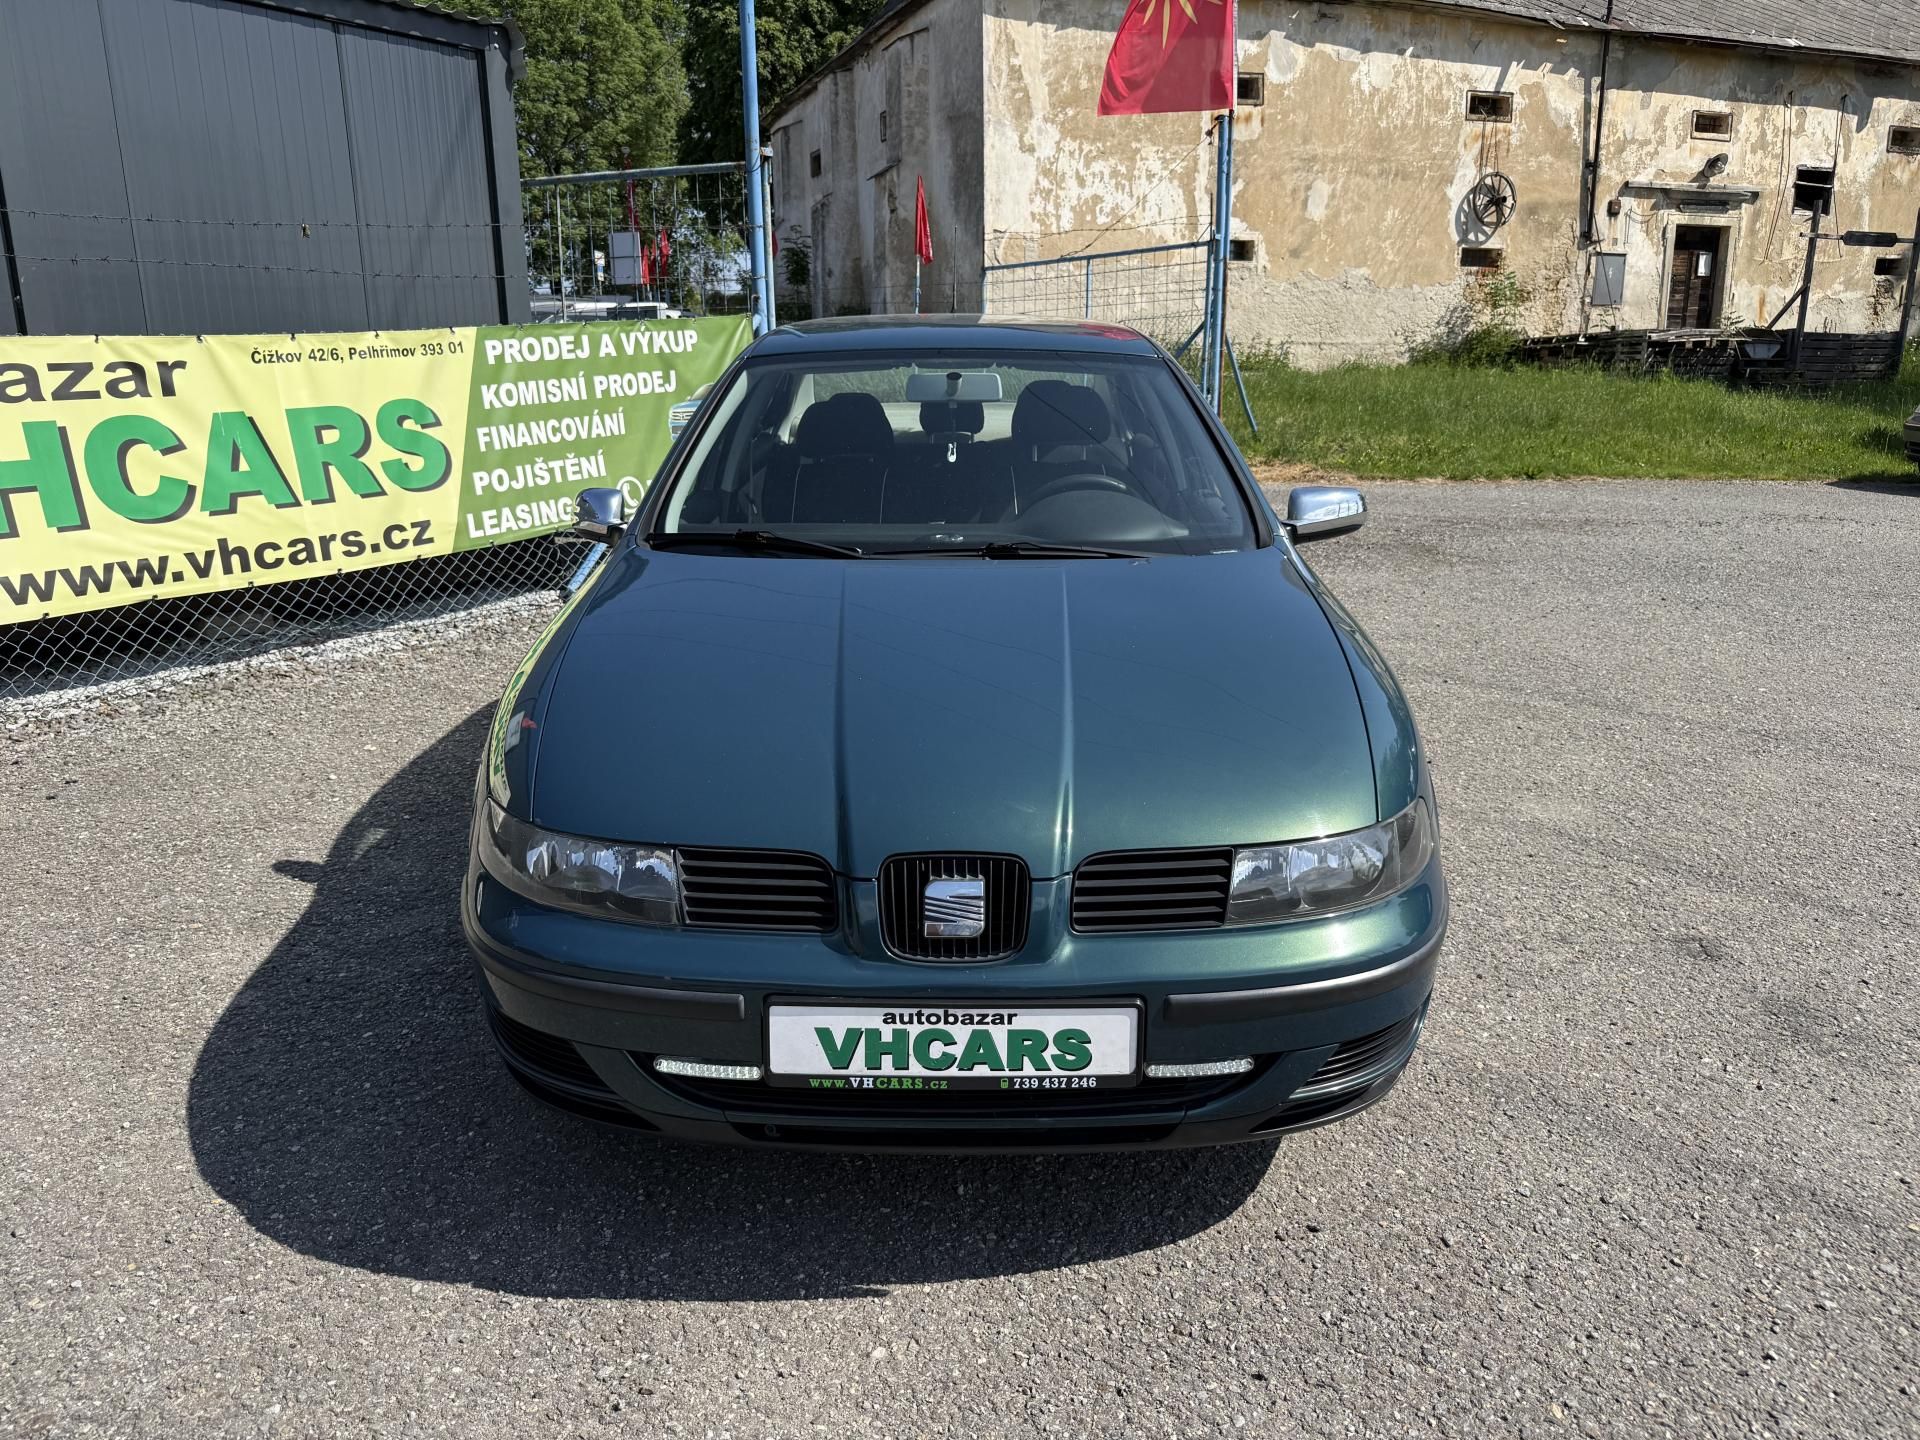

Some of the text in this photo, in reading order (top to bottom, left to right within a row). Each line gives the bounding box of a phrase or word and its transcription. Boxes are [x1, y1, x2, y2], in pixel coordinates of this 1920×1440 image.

[251, 341, 464, 364] Čížkov 42/6, Pelhřimov 393 01
[484, 325, 698, 365] PRODEJ A VÝKUP
[0, 360, 187, 404] azar
[481, 370, 677, 409] KOMISNÍ PRODEJ
[476, 407, 626, 452] FINANCOVÁNÍ
[472, 449, 607, 495] POJIŠTĚNÍ
[466, 496, 574, 539] LEASING
[0, 519, 434, 606] www.vhcars.cz
[882, 1009, 1018, 1026] autobazar
[814, 1027, 1093, 1072] VHCARS
[809, 1077, 948, 1089] www.VHCARS.cz
[1013, 1077, 1097, 1088] 739 437 246
